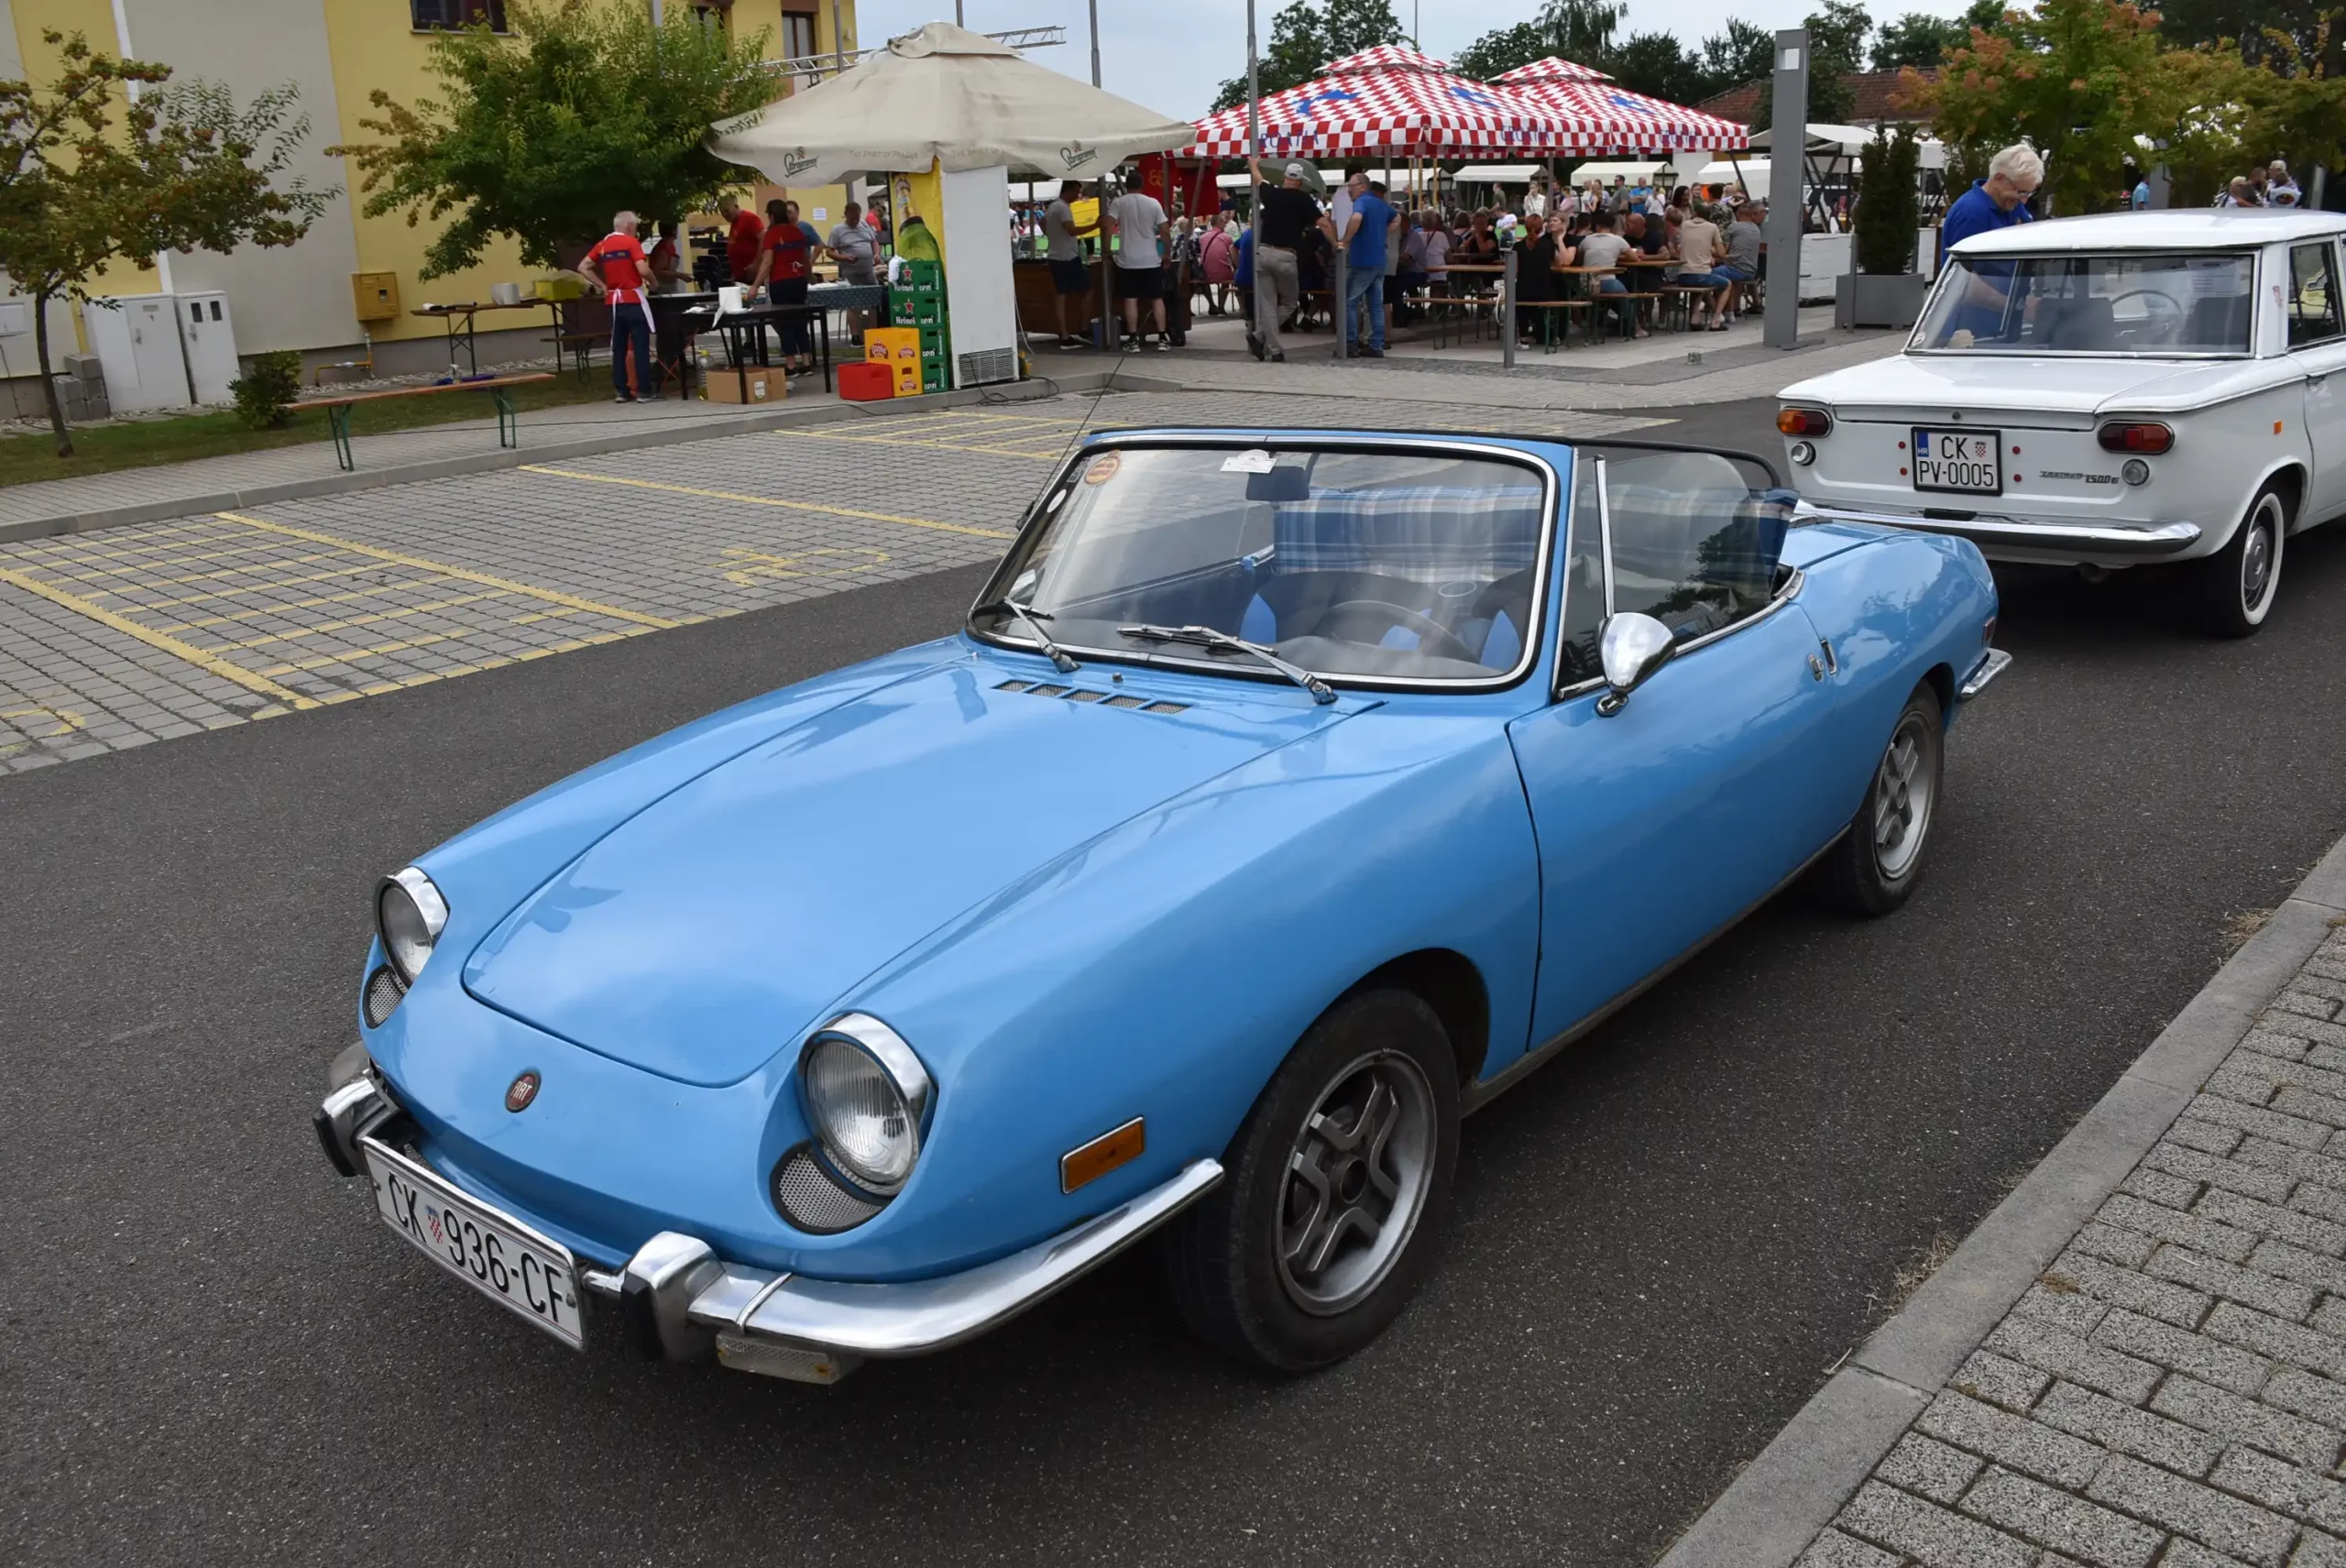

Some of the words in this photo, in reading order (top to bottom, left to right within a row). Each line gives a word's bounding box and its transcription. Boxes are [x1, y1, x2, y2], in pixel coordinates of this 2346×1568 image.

[1257, 130, 1319, 148] ROATIA
[1500, 125, 1551, 143] CROATIA
[1919, 460, 1994, 488] PV-0005
[510, 1080, 532, 1101] FIAT
[443, 1209, 564, 1323] 936-CF
